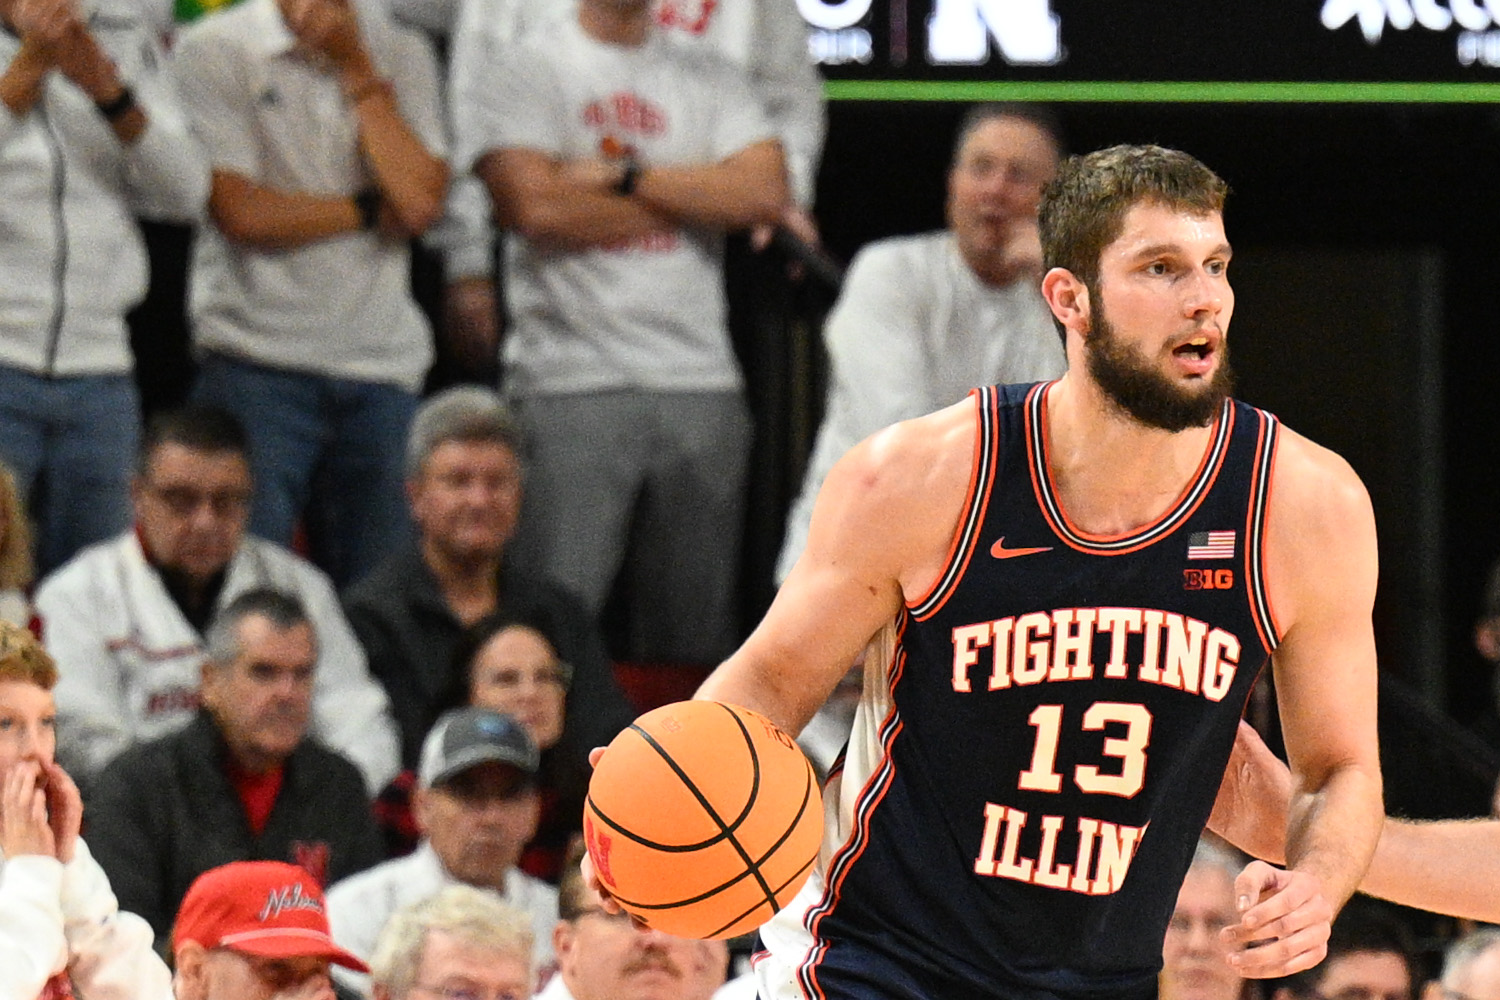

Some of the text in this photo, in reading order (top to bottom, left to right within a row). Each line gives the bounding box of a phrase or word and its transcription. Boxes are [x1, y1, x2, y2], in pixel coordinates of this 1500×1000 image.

[951, 607, 1242, 703] FIGHTING
[1017, 701, 1154, 800] 13
[974, 801, 1152, 896] ILLIN
